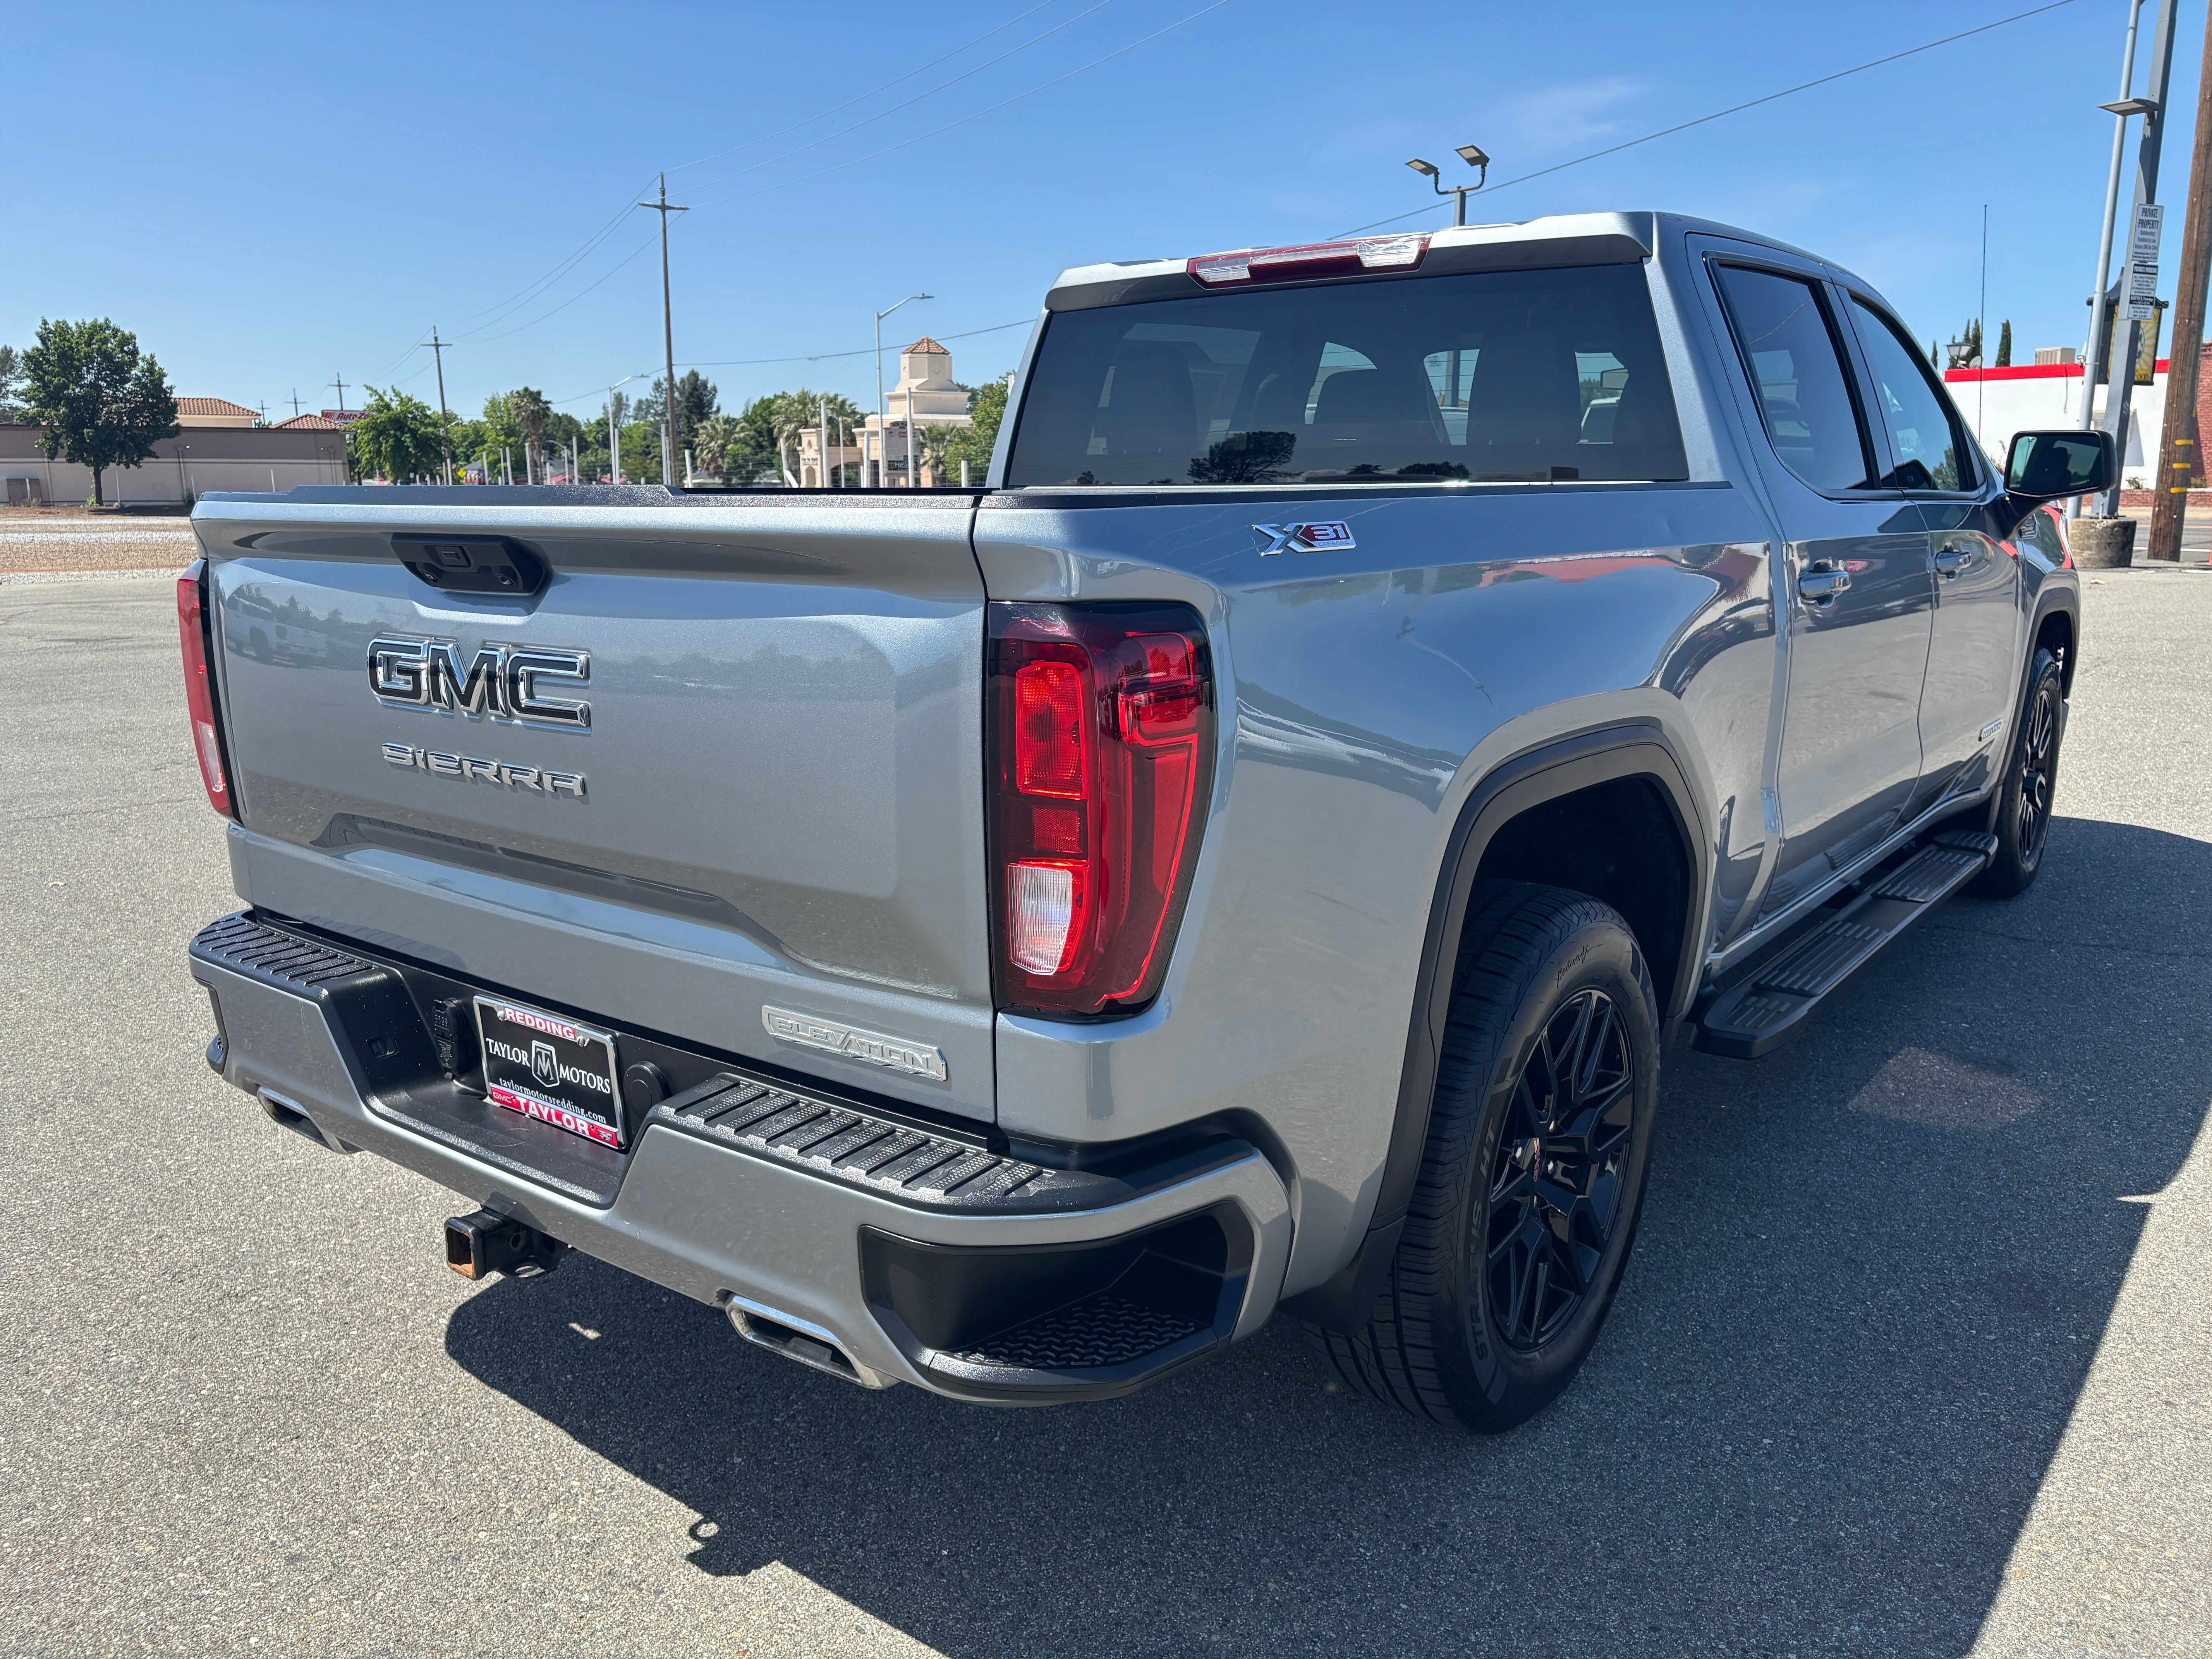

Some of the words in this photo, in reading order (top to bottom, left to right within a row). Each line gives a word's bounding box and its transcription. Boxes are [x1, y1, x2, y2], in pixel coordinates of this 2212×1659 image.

[2138, 218, 2160, 230] PROPERTY
[2142, 207, 2159, 218] PRIVATE
[367, 633, 591, 727] GMC
[381, 743, 586, 796] SIERRA
[505, 1007, 576, 1040] REDDING
[775, 1017, 932, 1069] ELEVATION
[486, 1037, 531, 1067] TAYLOR
[559, 1063, 611, 1094] MOTORS
[493, 1092, 512, 1104] GMC
[499, 1077, 606, 1124] taylormotorsredding.com
[516, 1096, 590, 1136] TAYLOR
[1468, 1200, 1488, 1360] STRATUS
[1479, 1118, 1496, 1180] HT
